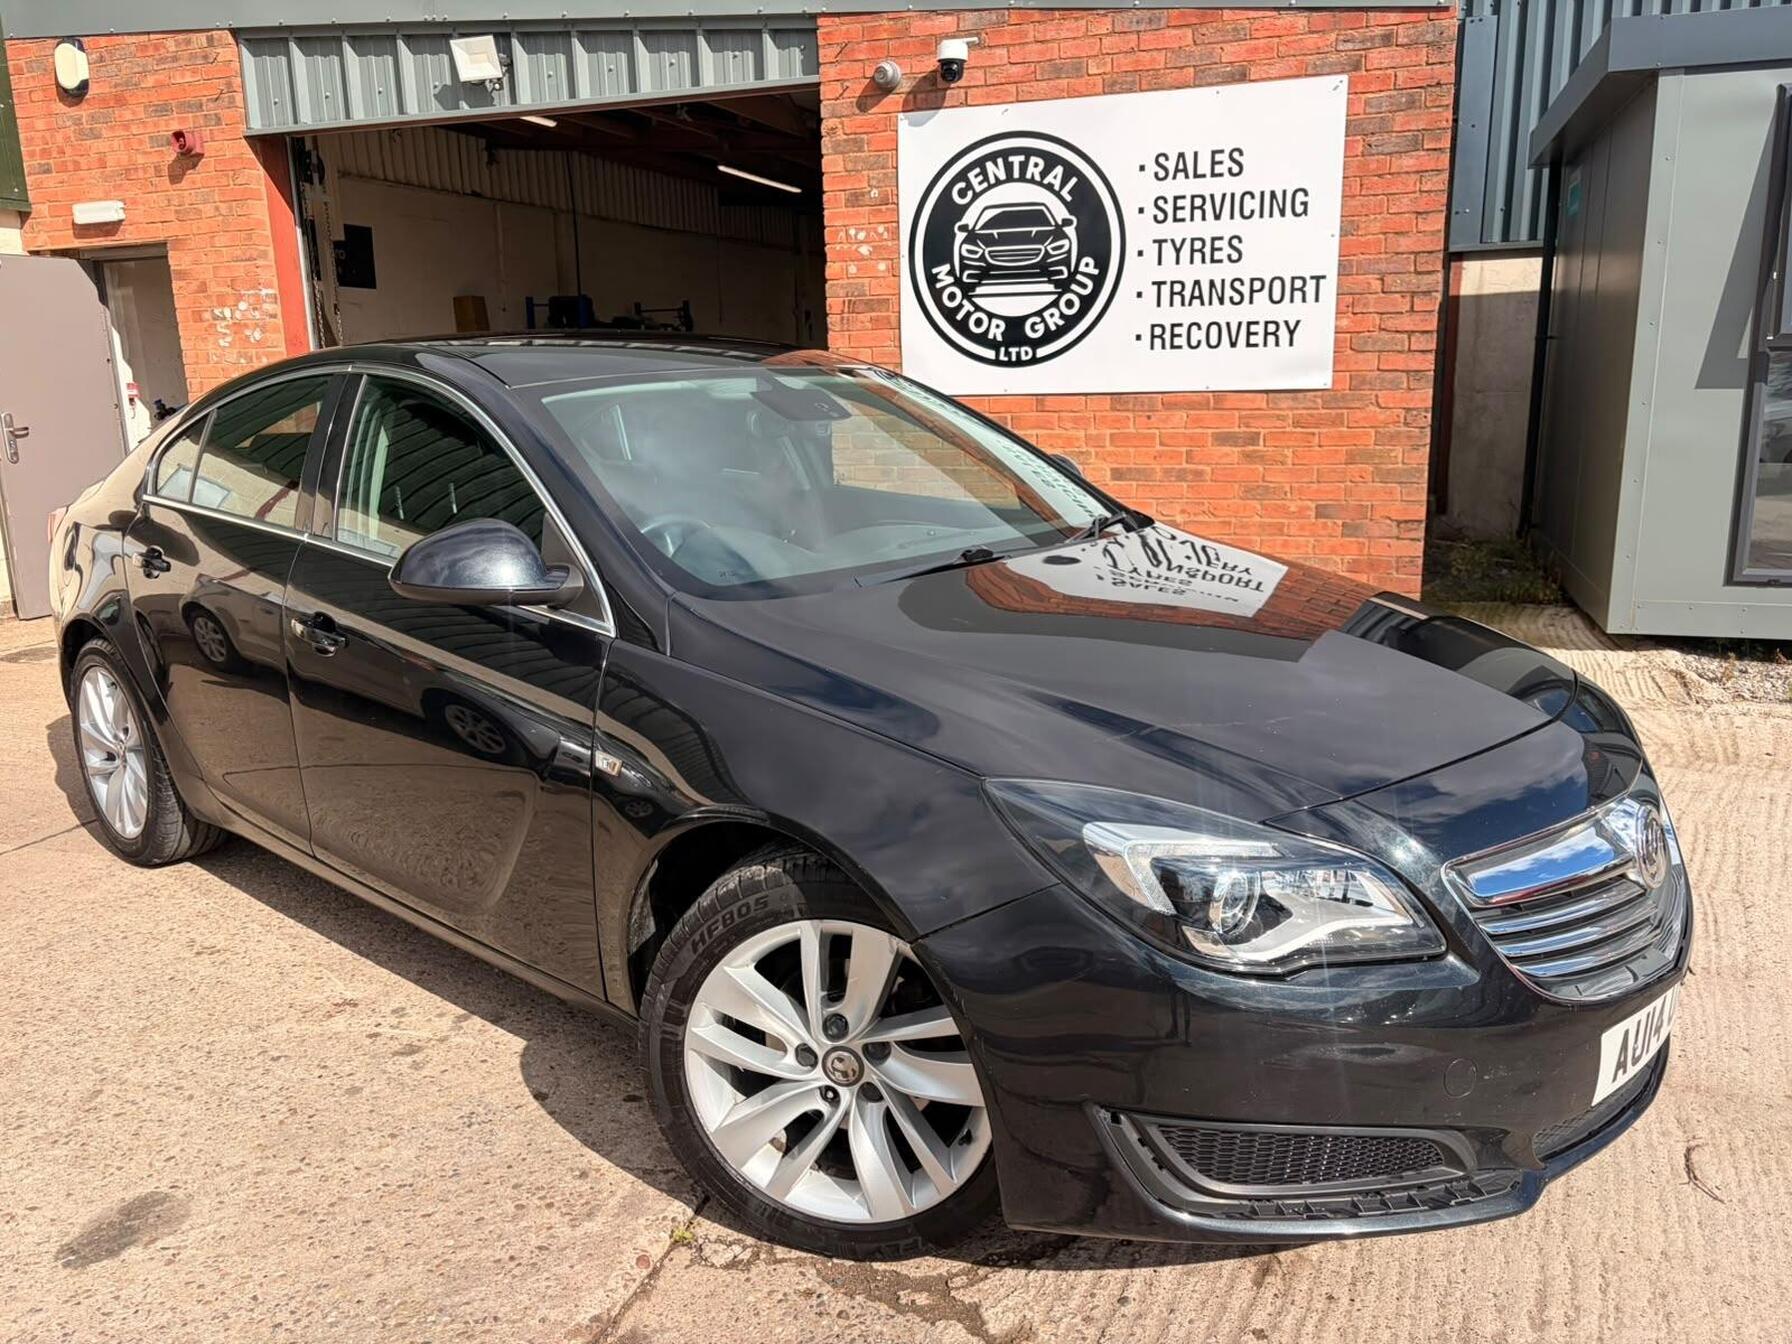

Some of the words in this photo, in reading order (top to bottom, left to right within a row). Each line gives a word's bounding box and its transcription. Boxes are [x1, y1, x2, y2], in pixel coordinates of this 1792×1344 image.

[951, 155, 1078, 205] CENTRAL
[1154, 147, 1245, 182] SALES
[1153, 188, 1309, 224] SERVICING
[1152, 235, 1243, 266] TYRES
[931, 263, 1006, 341] MOTOR
[1024, 256, 1100, 339] GROUP
[1151, 275, 1327, 308] TRANSPORT
[1150, 319, 1302, 350] RECOVERY
[999, 346, 1034, 362] LTD
[690, 894, 770, 955] HF805
